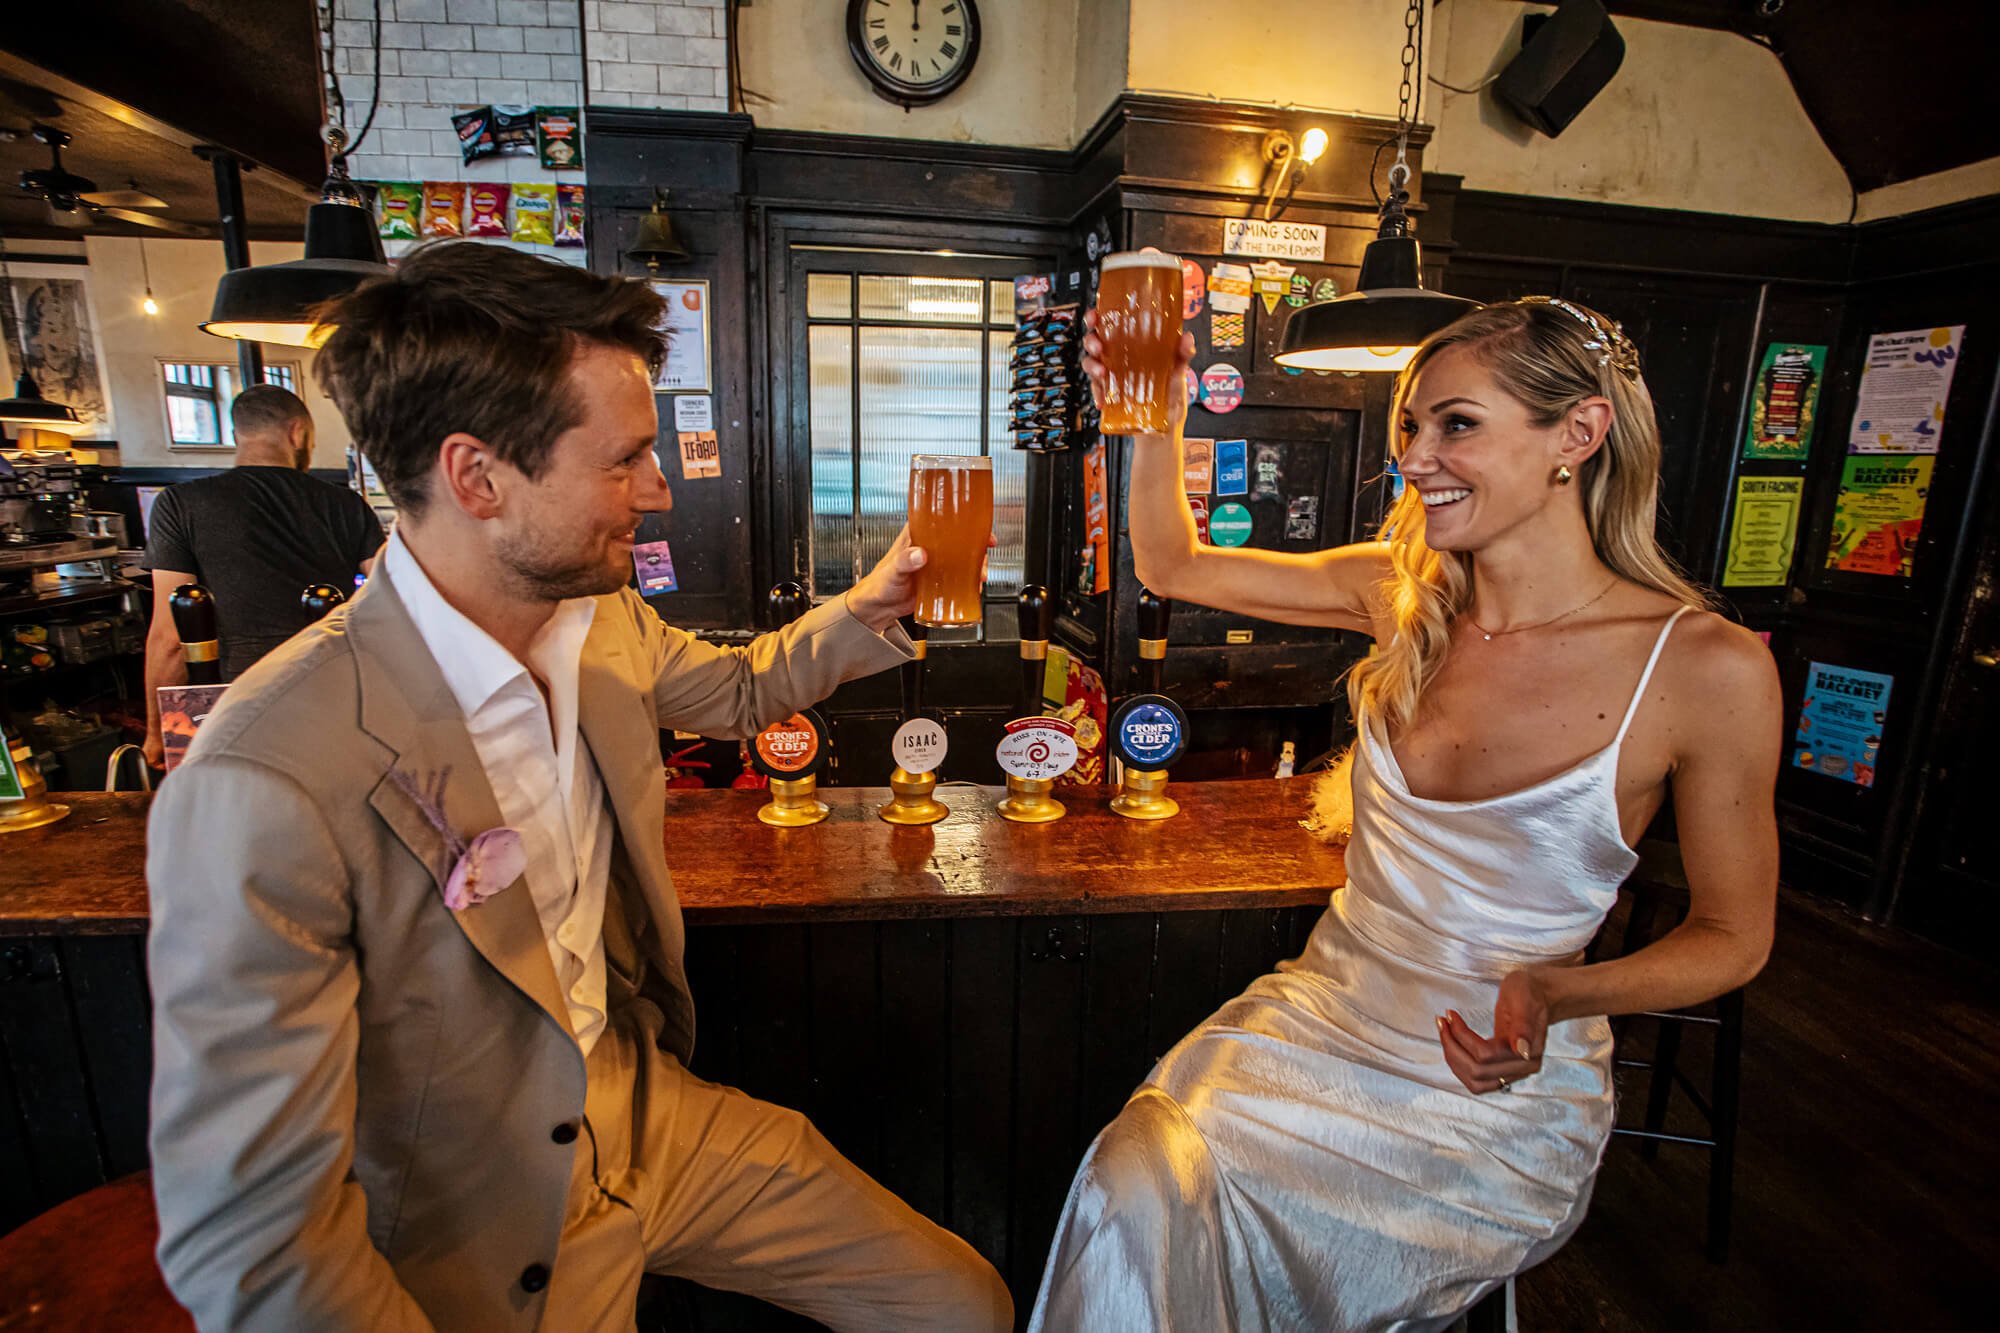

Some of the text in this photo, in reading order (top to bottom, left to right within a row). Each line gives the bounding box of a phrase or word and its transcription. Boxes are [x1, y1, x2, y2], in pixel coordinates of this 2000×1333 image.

[1229, 222, 1319, 241] COMING SOON
[1229, 240, 1242, 250] ON
[1246, 242, 1263, 253] THE
[1267, 243, 1287, 255] TAPS
[1295, 245, 1321, 257] PUMPS
[684, 439, 717, 460] IFORD
[1854, 474, 1918, 484] HACKNEY
[1816, 679, 1883, 701] HACKNEY
[769, 741, 809, 751] CIDER
[903, 731, 937, 748] ISAAC
[1012, 732, 1030, 743] ROSS
[1130, 734, 1170, 744] CIDER
